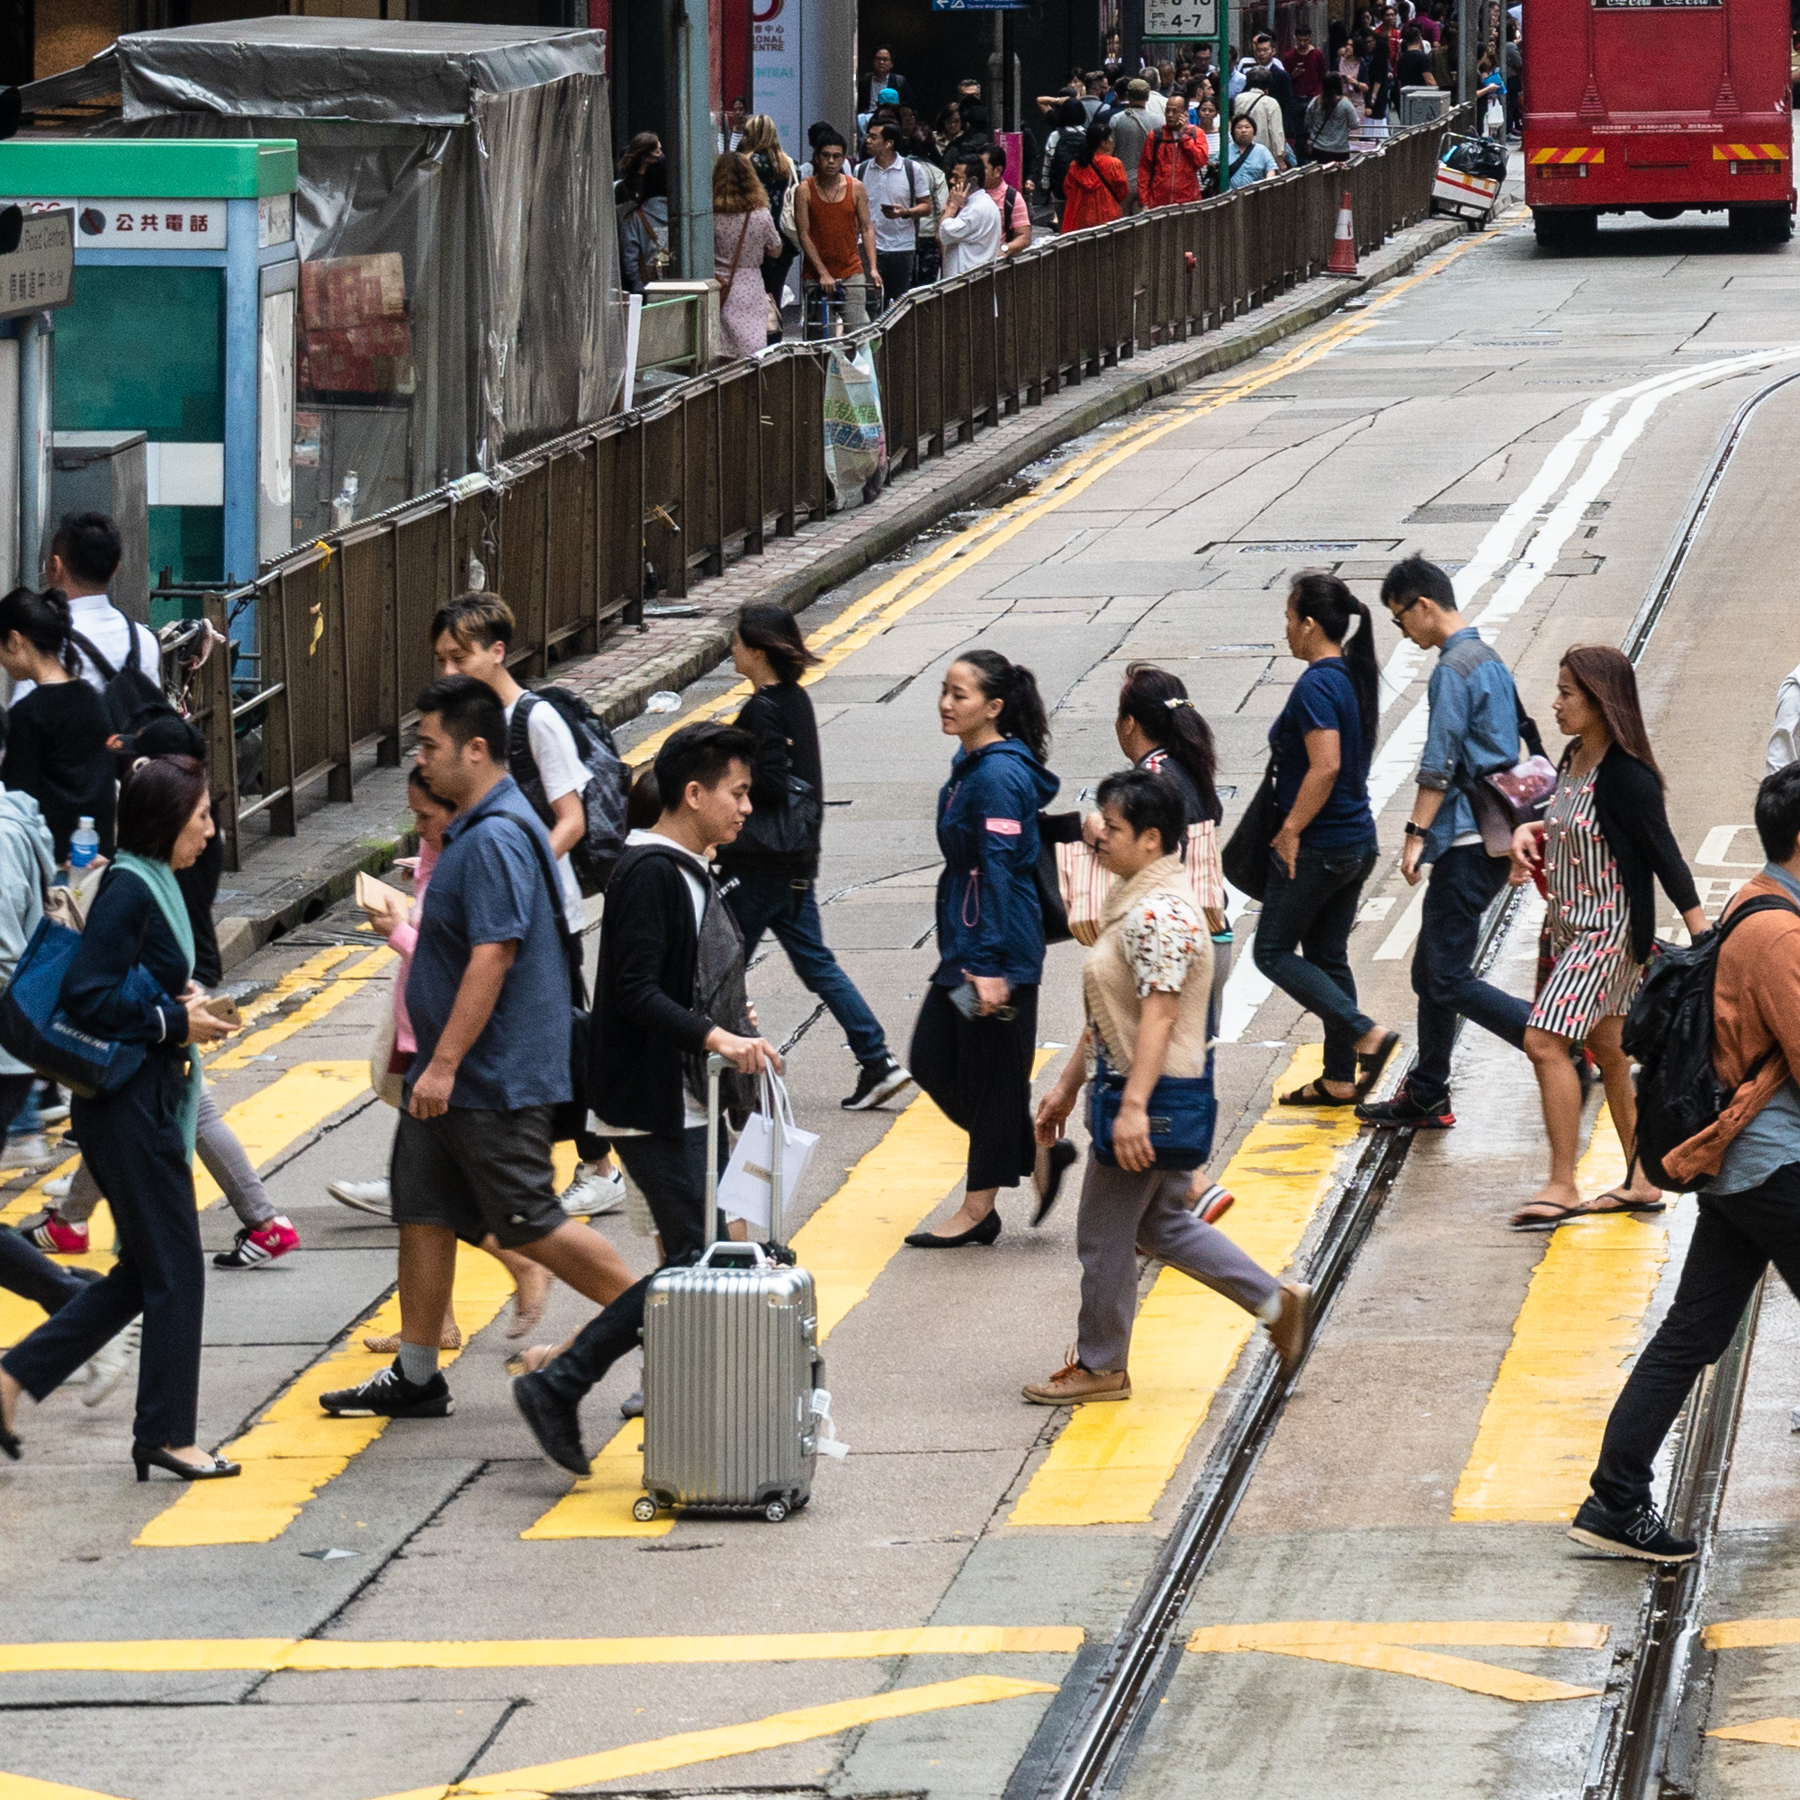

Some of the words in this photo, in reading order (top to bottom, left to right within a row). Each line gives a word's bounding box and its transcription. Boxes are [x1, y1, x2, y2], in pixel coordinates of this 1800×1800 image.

[1171, 14, 1202, 28] 4-7
[116, 213, 209, 233] 公共電話
